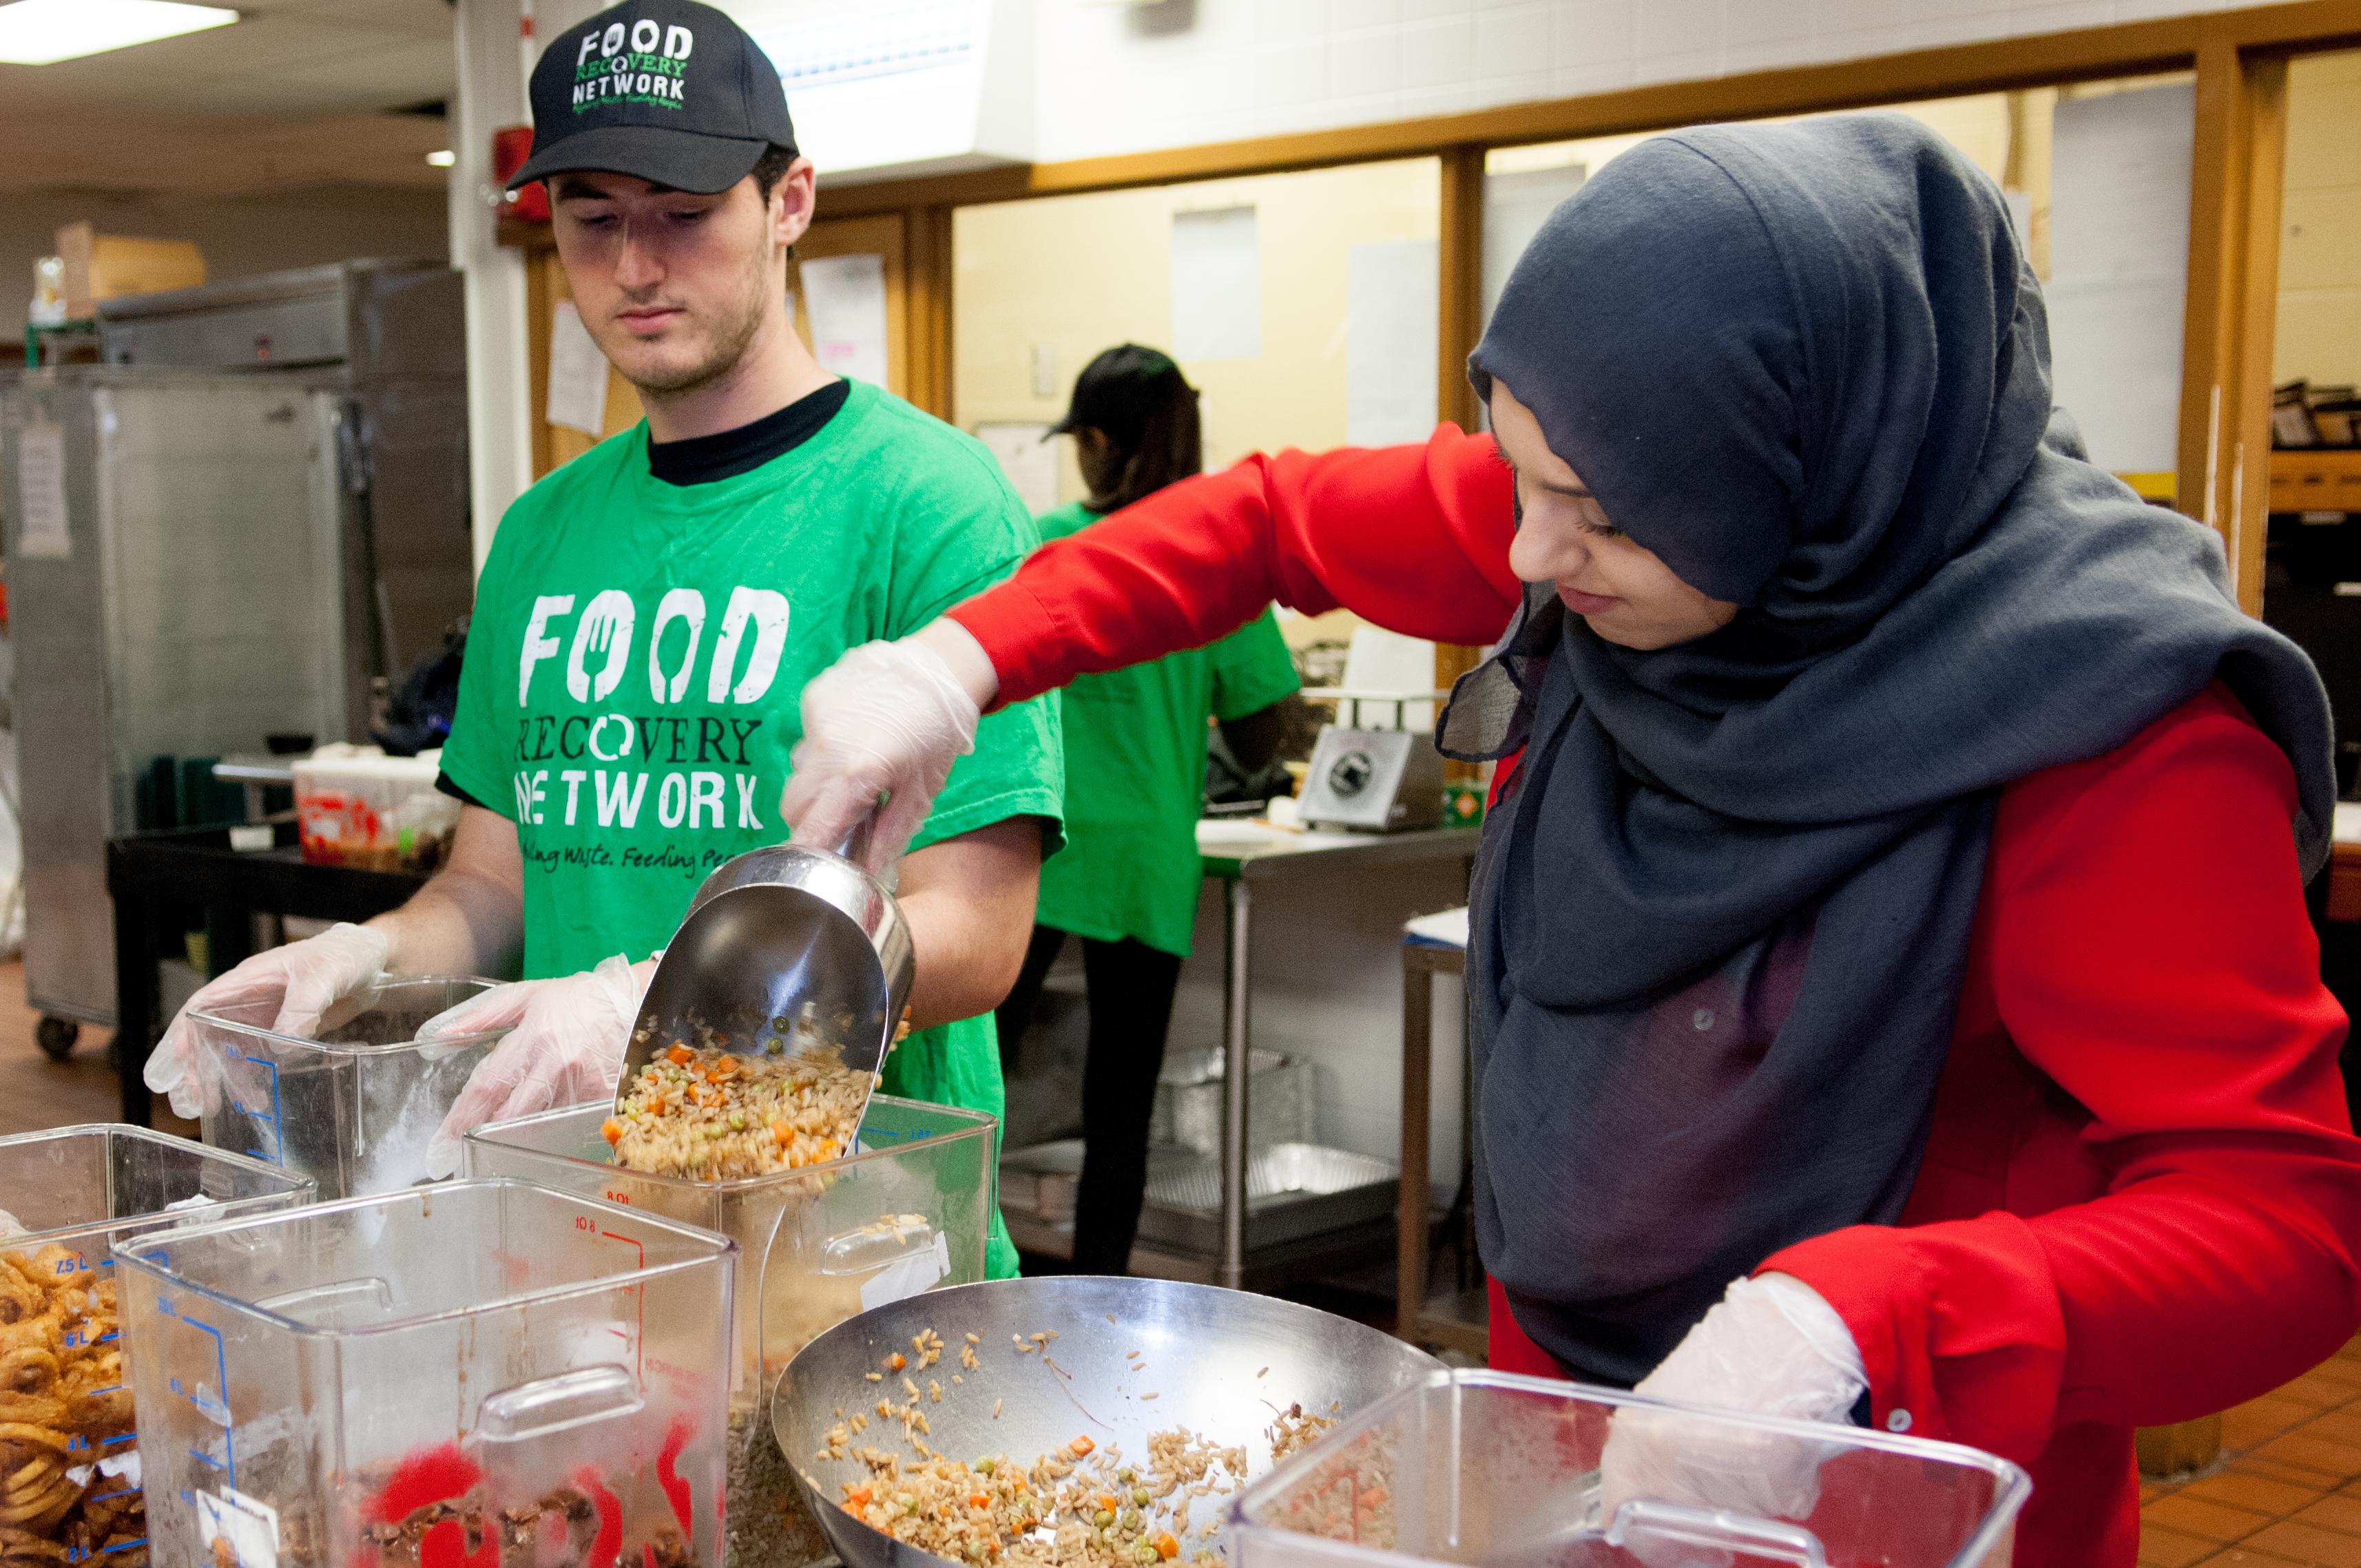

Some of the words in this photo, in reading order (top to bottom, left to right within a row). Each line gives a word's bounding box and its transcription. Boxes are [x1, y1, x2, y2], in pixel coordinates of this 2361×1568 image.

[577, 19, 693, 66] FOOD
[572, 73, 685, 105] NETWORK
[574, 52, 688, 83] RECOVERY
[519, 585, 790, 708] FOOD
[514, 713, 762, 766] RECOVERY
[514, 770, 764, 830] NETWORK
[621, 844, 696, 879] Feeding
